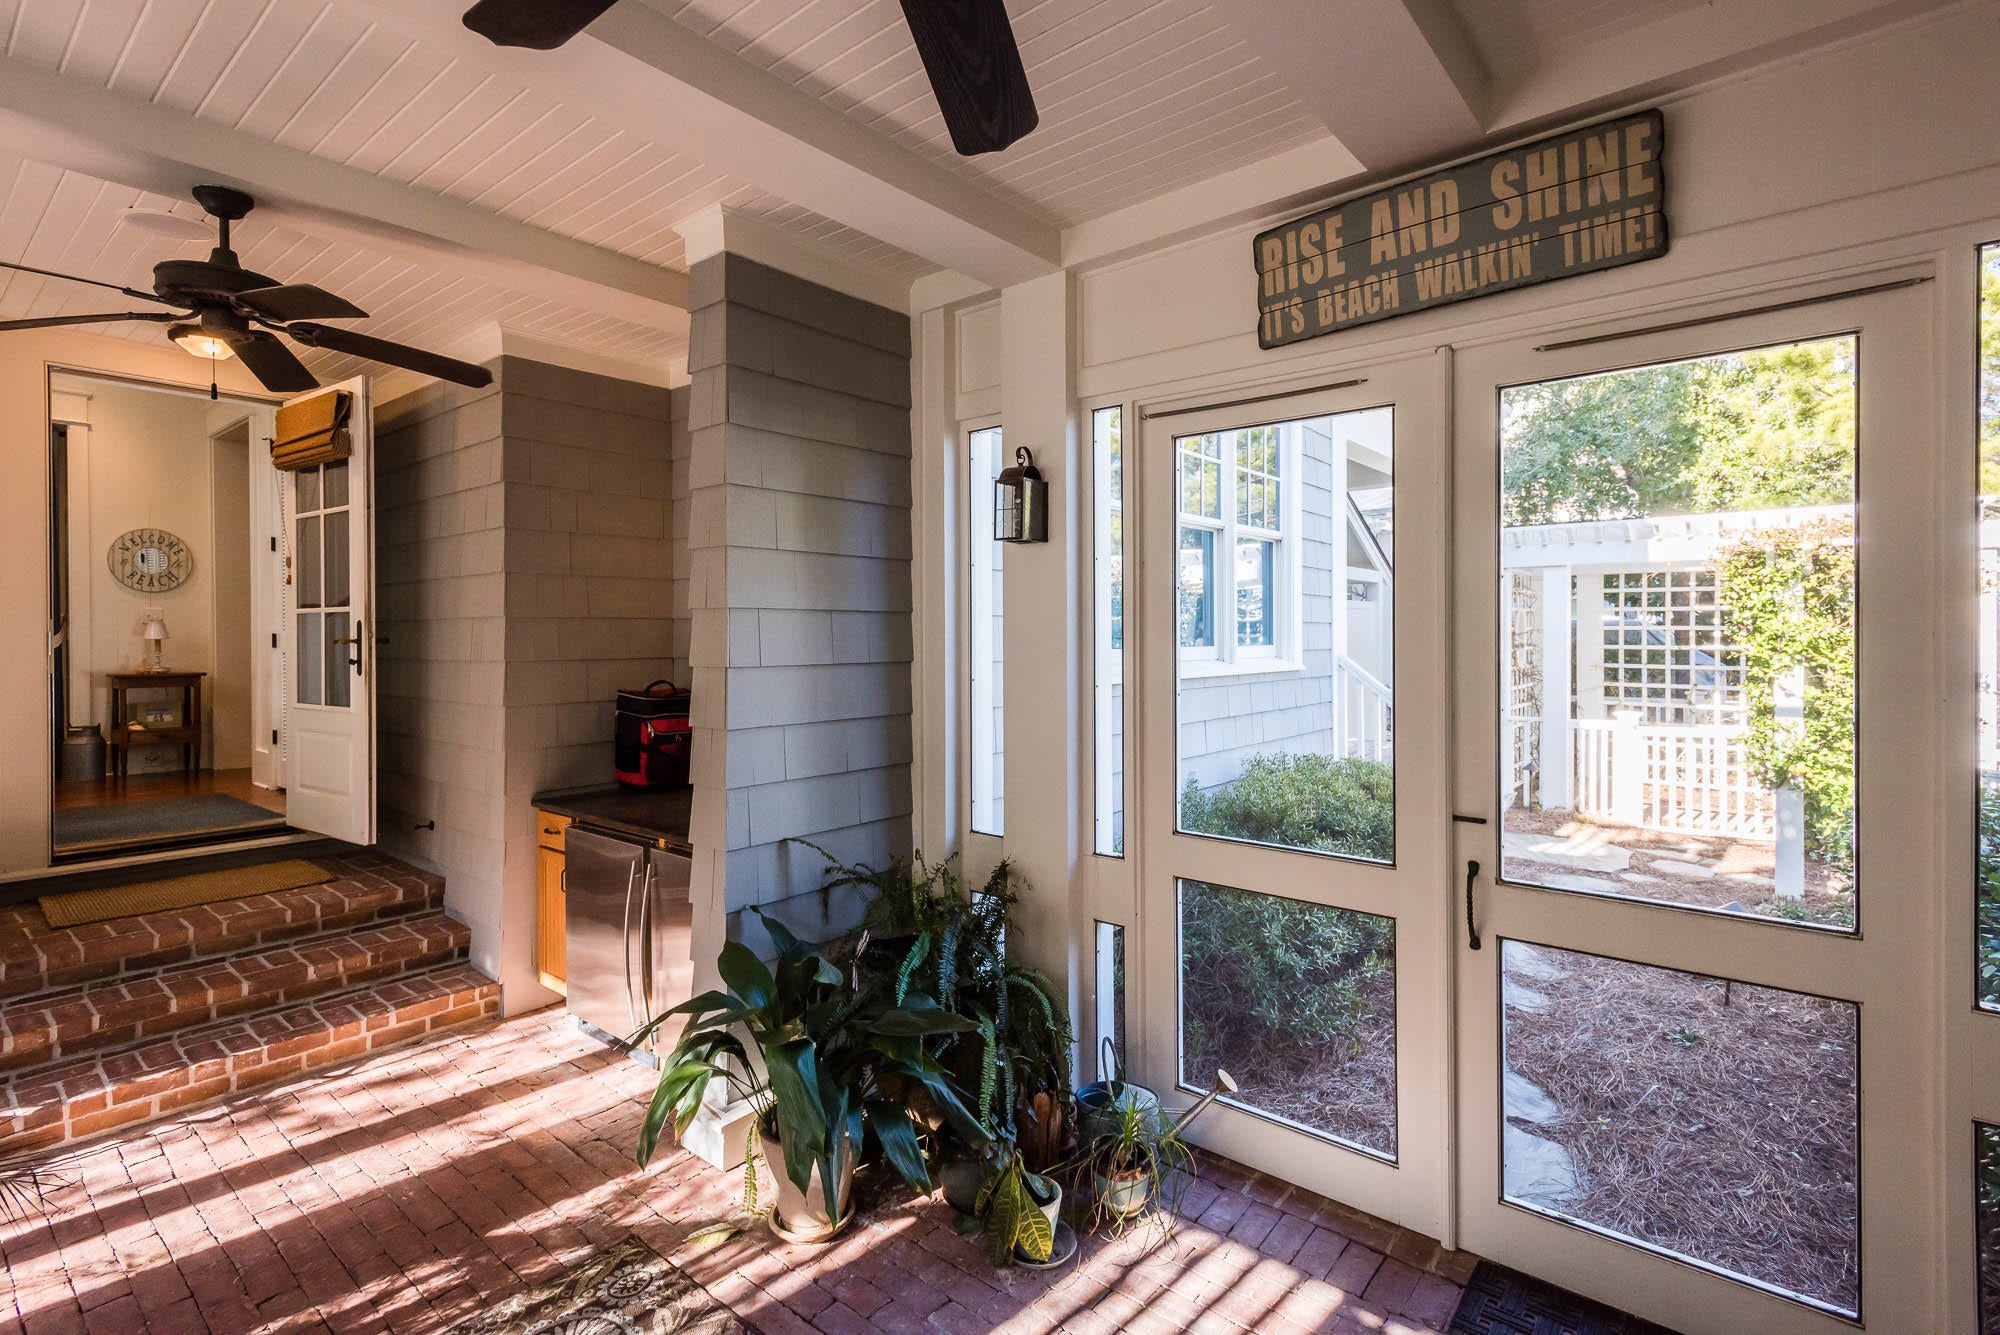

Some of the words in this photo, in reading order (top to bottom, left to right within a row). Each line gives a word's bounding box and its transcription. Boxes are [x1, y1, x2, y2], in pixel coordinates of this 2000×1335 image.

[1262, 215, 1345, 296] RISE
[1370, 179, 1460, 265] AND
[1490, 123, 1654, 230] SHINE
[1263, 296, 1305, 341] IT'S
[1317, 269, 1399, 327] BEACH
[1415, 232, 1540, 302] WALKIN'
[1559, 204, 1656, 267] TIME!
[118, 534, 184, 555] WELCOME
[127, 570, 180, 588] BEACH
